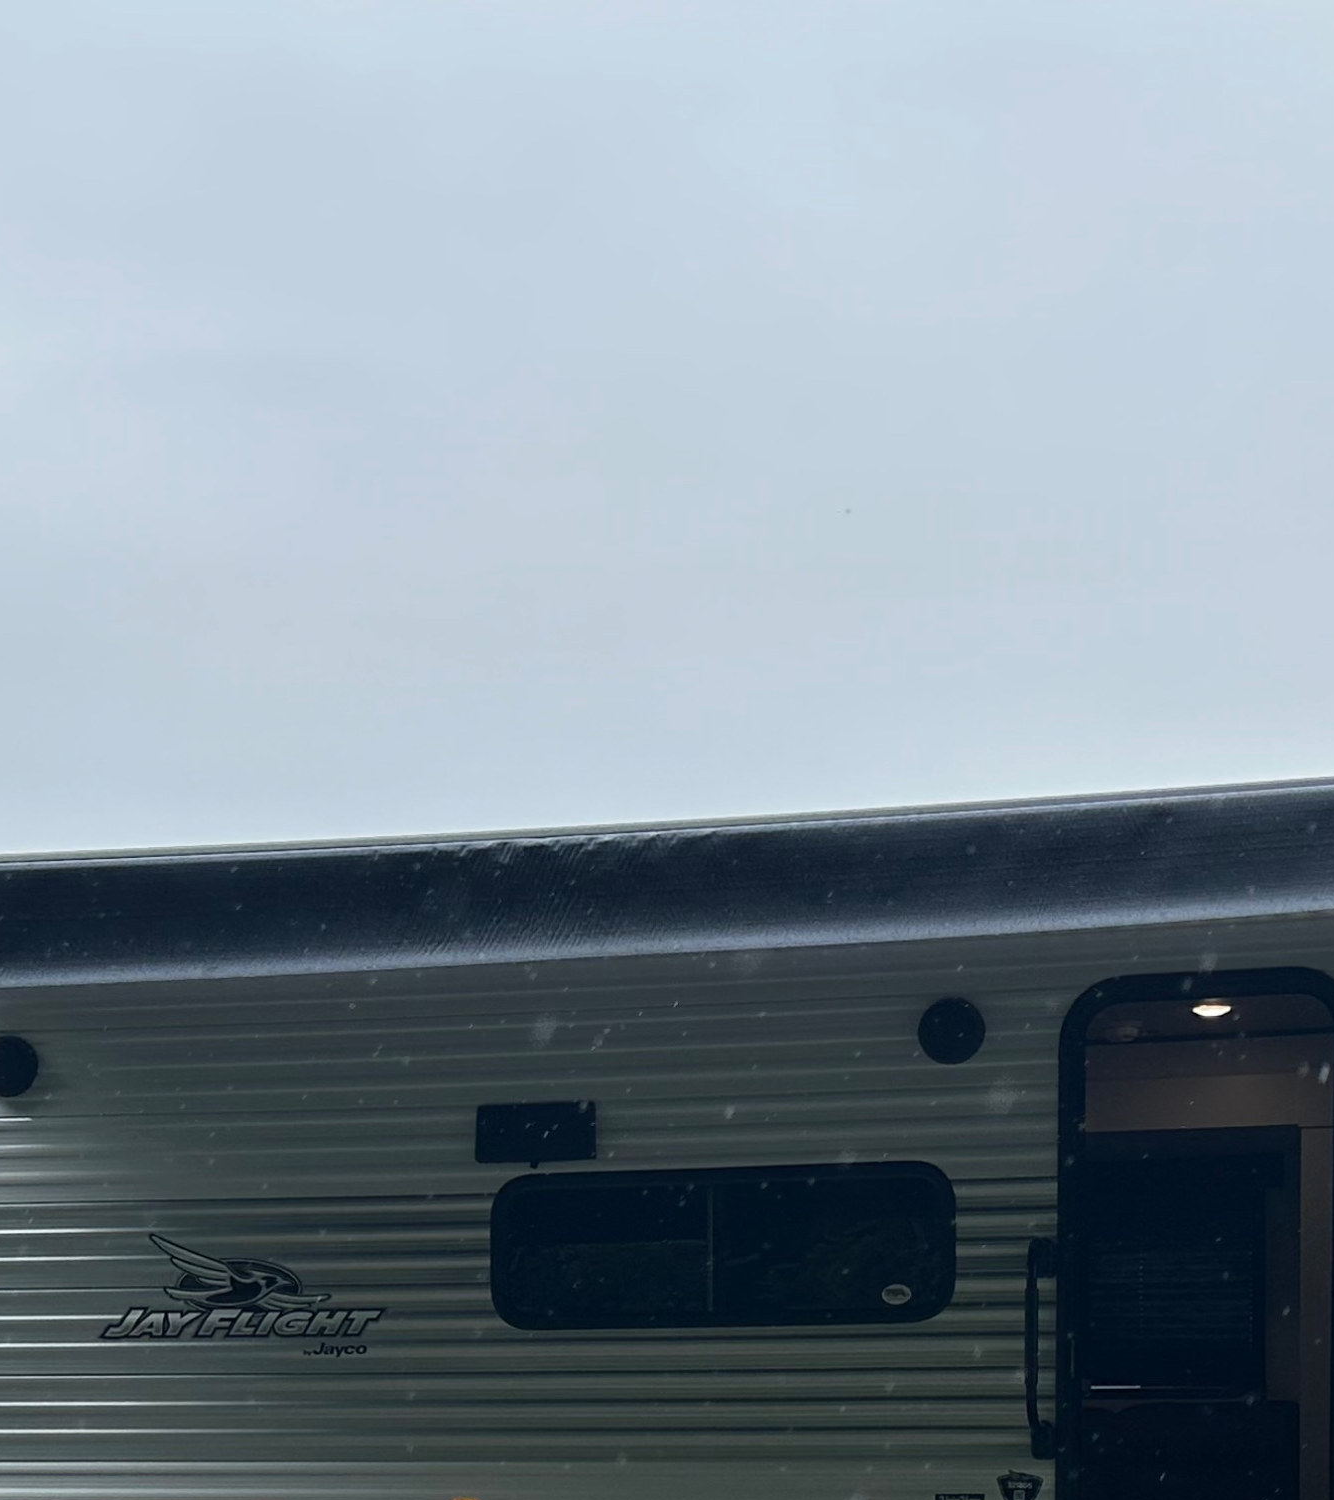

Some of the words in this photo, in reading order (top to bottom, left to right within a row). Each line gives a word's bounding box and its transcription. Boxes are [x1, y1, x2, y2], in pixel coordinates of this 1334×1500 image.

[100, 1306, 201, 1338] JAY
[193, 1308, 387, 1338] FLIGHT
[312, 1342, 367, 1357] Jayco
